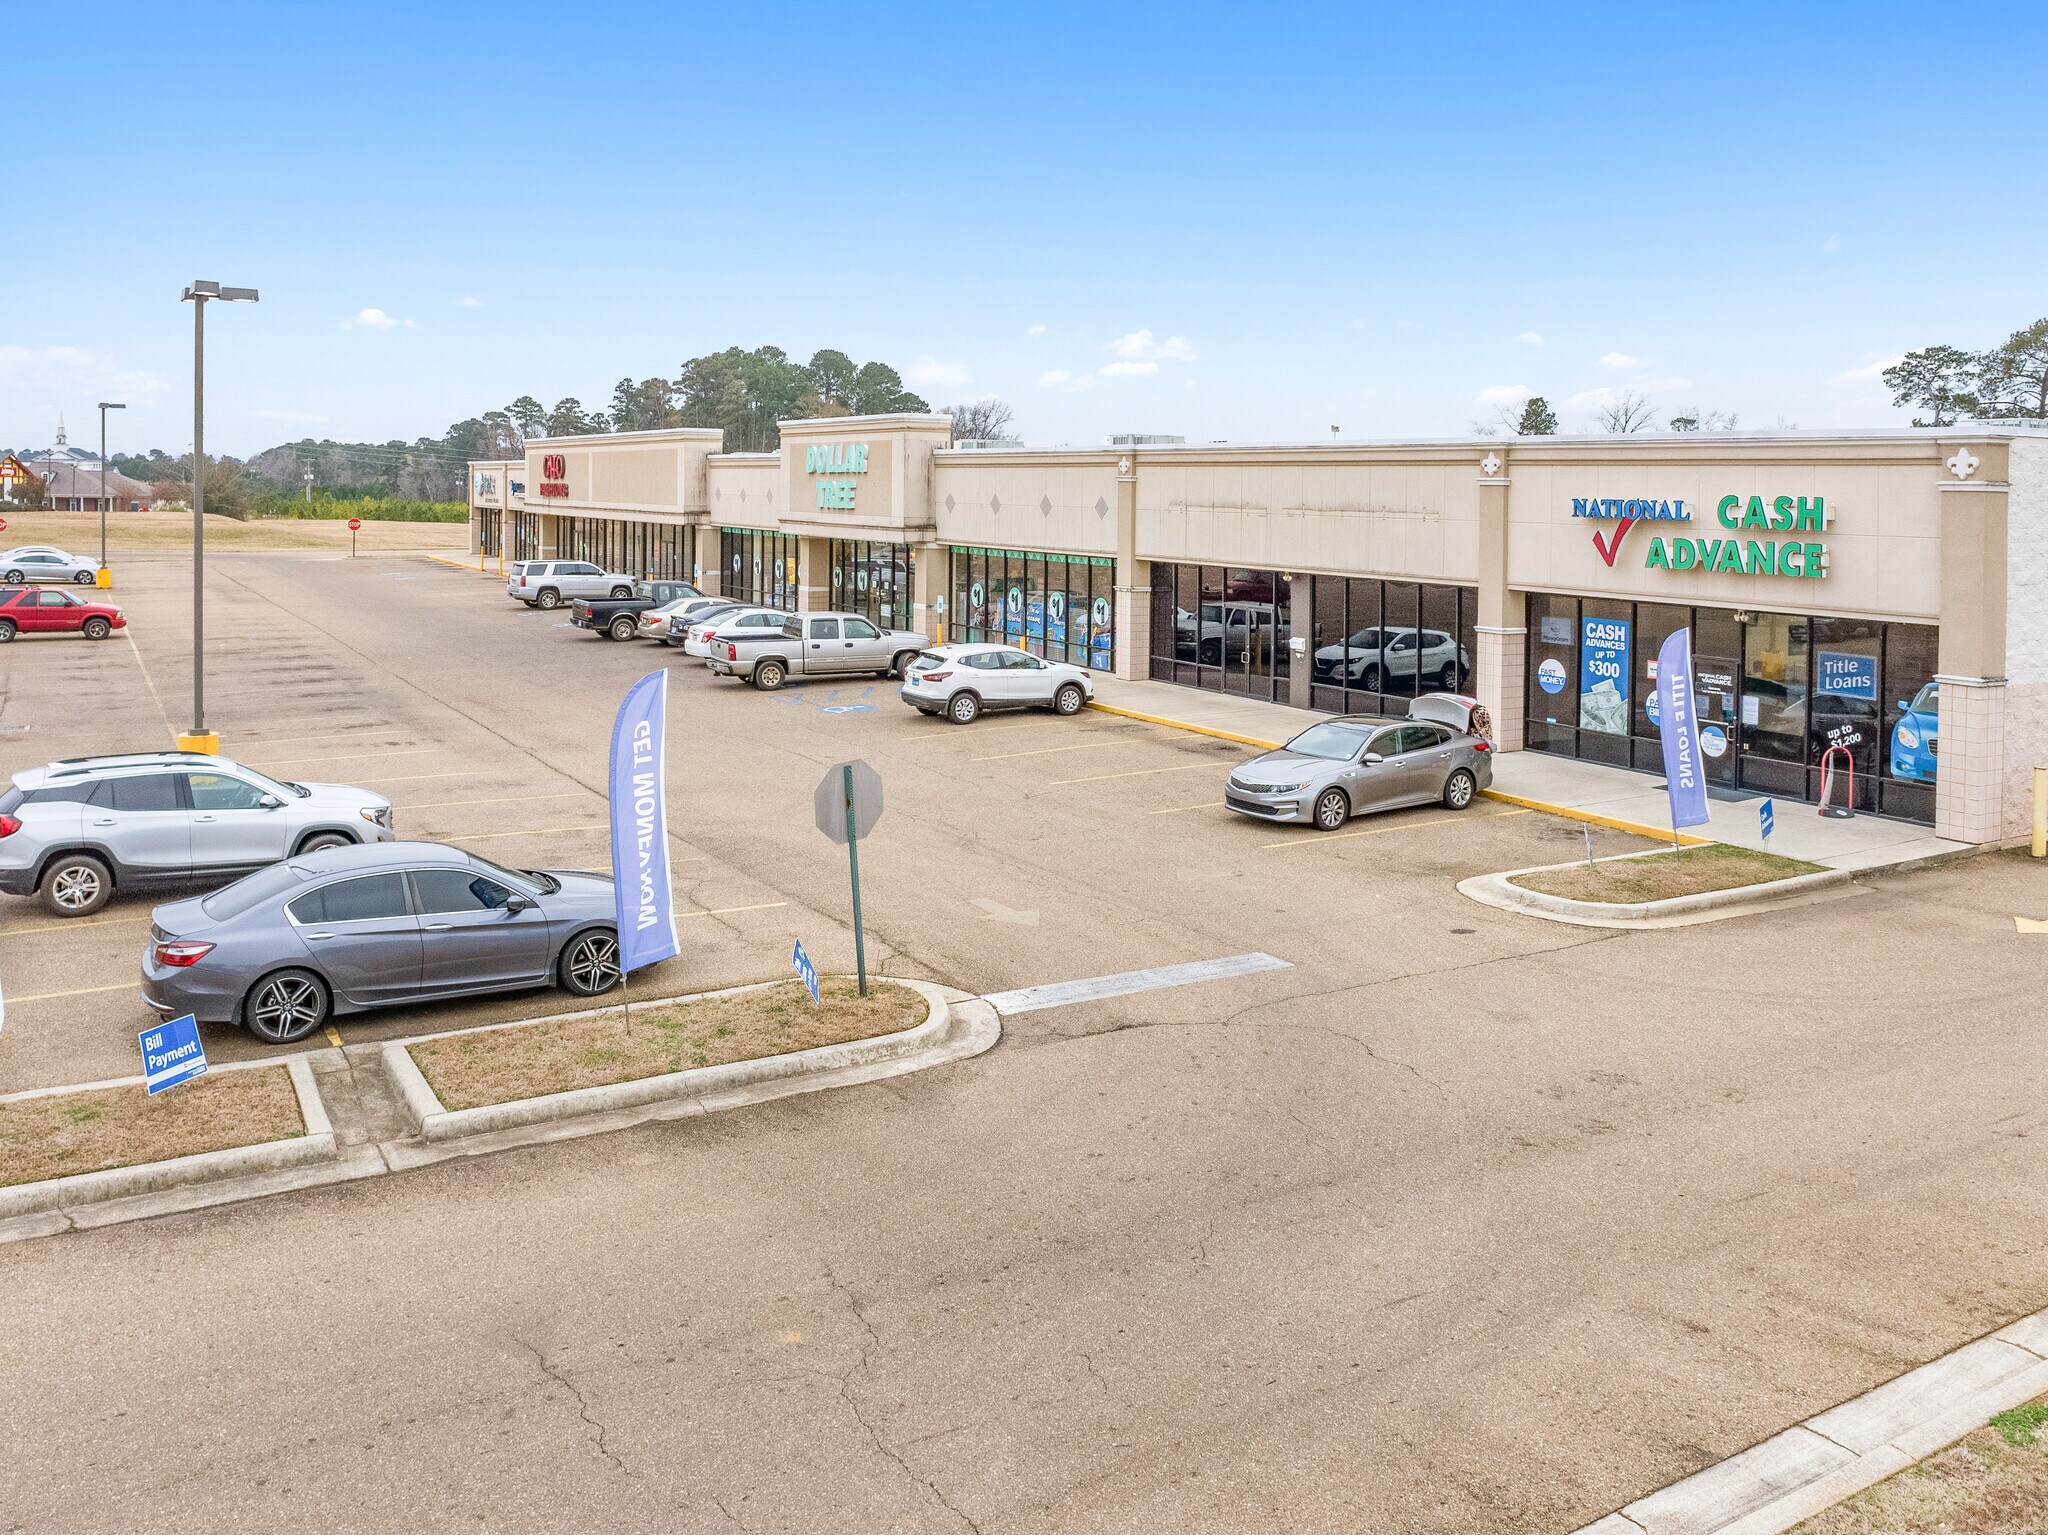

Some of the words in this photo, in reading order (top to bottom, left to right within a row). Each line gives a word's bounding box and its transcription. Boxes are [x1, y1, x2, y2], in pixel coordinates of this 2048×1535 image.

[806, 444, 868, 474] DOLLAR
[816, 481, 857, 509] TREE
[1572, 498, 1693, 521] NATIONAL
[1717, 495, 1827, 531] CASH
[1645, 537, 1826, 578] ADVANCE
[1052, 598, 1060, 617] $1
[1096, 604, 1105, 624] $1
[1586, 623, 1626, 641] CASH
[1586, 638, 1626, 650] ADVANCES
[1541, 668, 1556, 677] FAST
[1589, 660, 1620, 678] $300
[1825, 659, 1859, 674] Title
[1825, 675, 1871, 689] Loans
[1827, 727, 1840, 740] up
[1841, 724, 1853, 735] to
[1830, 733, 1862, 749] $1,200
[145, 1032, 163, 1052] Bill
[148, 1040, 198, 1070] Payment
